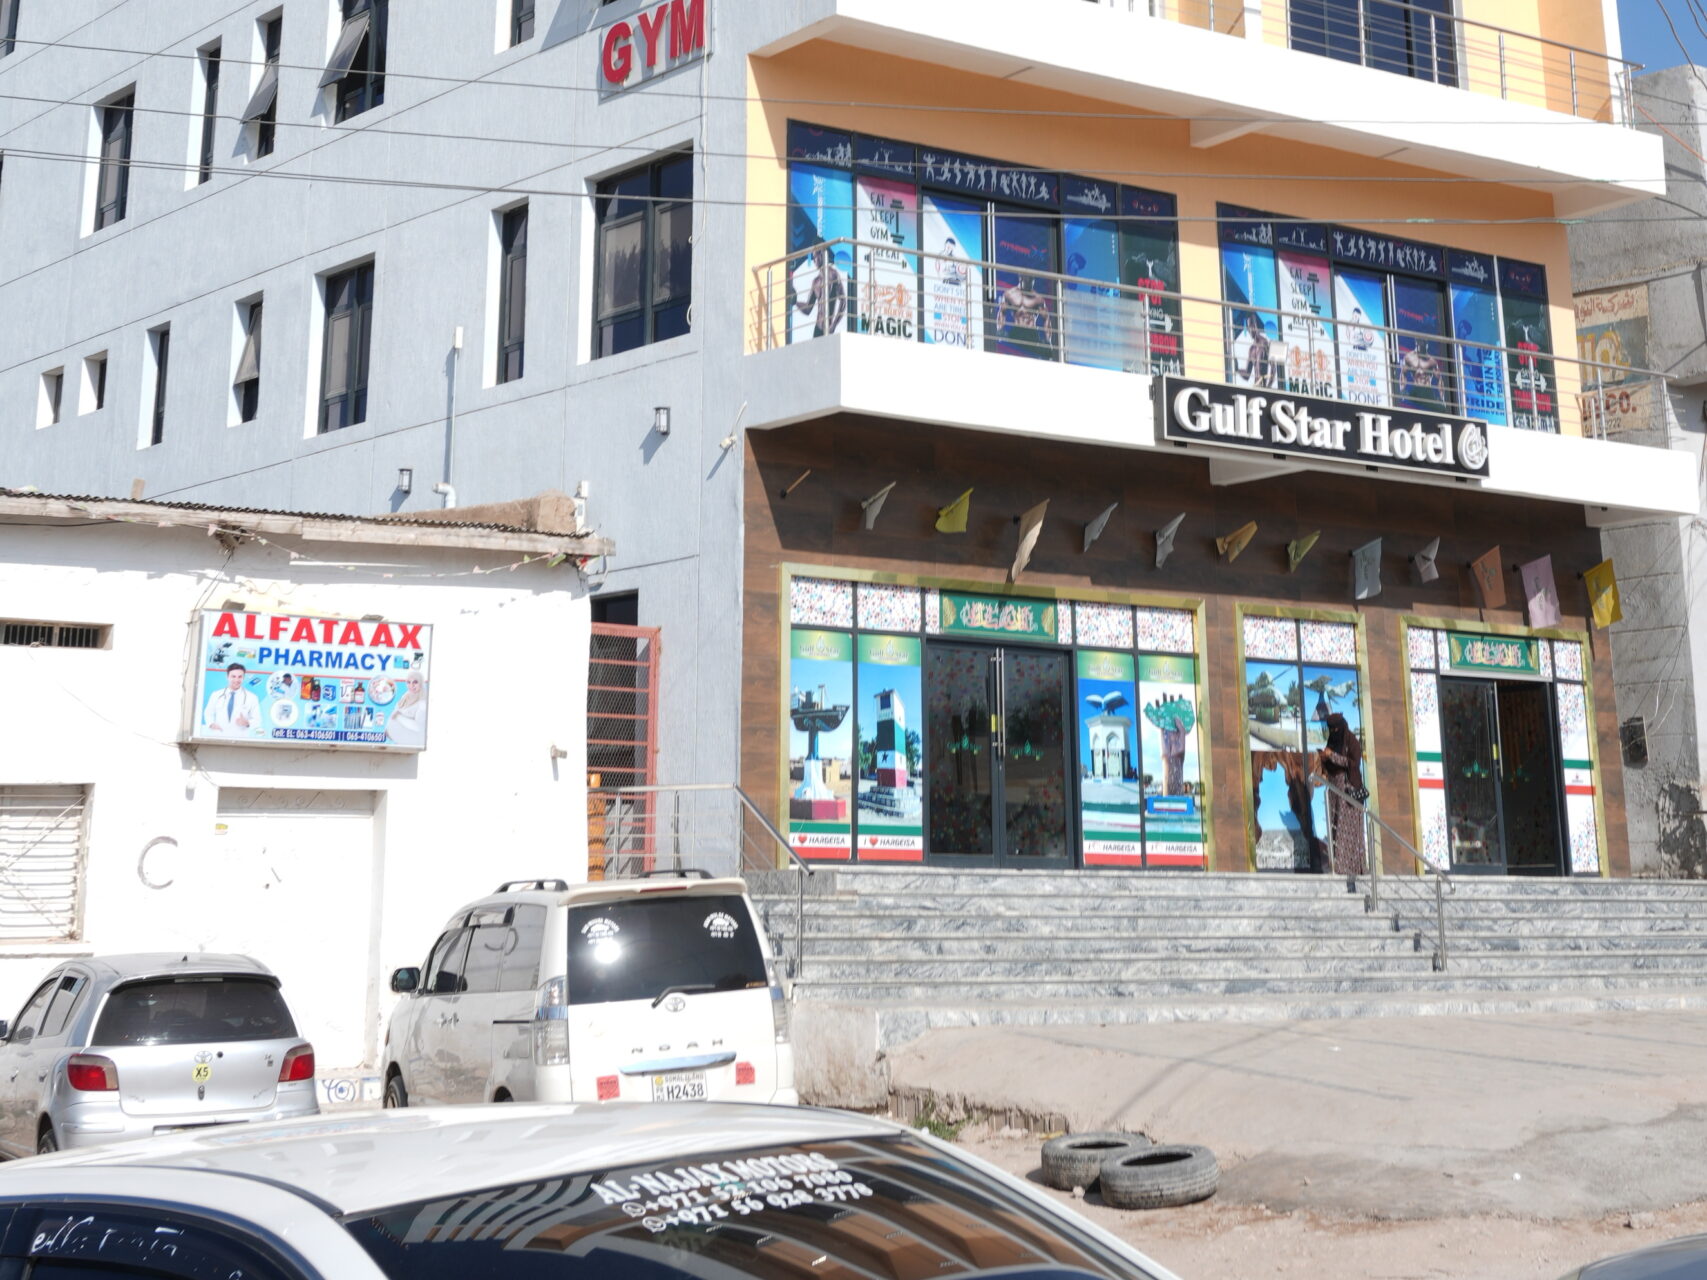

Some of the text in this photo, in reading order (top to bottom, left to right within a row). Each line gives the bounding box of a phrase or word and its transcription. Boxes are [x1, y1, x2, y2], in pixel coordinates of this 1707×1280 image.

[870, 227, 889, 241] GYM
[1174, 385, 1455, 465] Gulf Star Hotel
[212, 612, 423, 650] ALFATAAX
[258, 647, 393, 671] PHARMACY
[809, 837, 845, 845] HARGEISA
[880, 839, 915, 847] HARGEISA
[1102, 843, 1135, 852] HARGEISA
[1165, 843, 1197, 852] HARGEISA
[666, 1083, 704, 1100] H2438
[724, 1152, 838, 1182] MOTORS
[645, 1190, 709, 1211] +971
[664, 1202, 729, 1226] +971
[731, 1198, 764, 1216] 56
